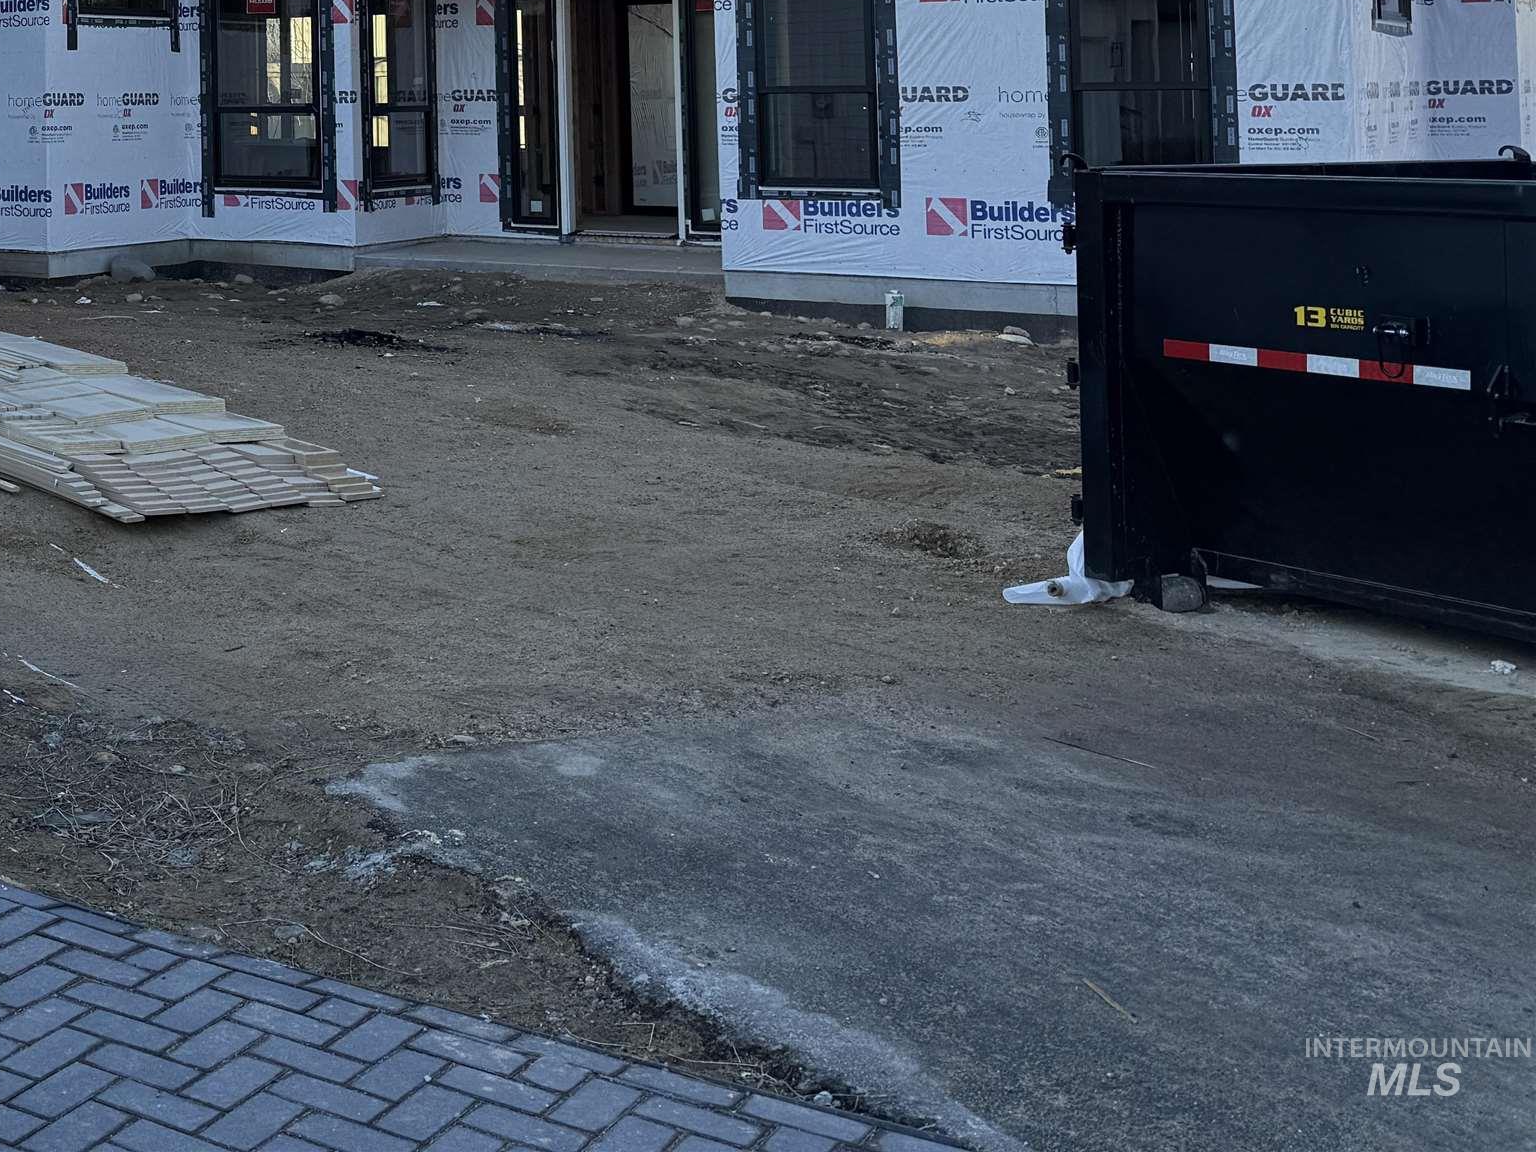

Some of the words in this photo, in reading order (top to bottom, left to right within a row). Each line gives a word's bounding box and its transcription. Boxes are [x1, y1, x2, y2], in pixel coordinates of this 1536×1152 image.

[7, 92, 85, 108] homeGUARD
[96, 92, 160, 107] homeGUARD
[1247, 127, 1320, 136] oxep.com
[84, 183, 131, 201] Builders
[84, 202, 131, 216] FirstSource
[803, 218, 901, 236] FirstSource
[1293, 305, 1327, 328] 13
[1330, 307, 1365, 318] CUBIC
[1330, 315, 1365, 325] YARDS
